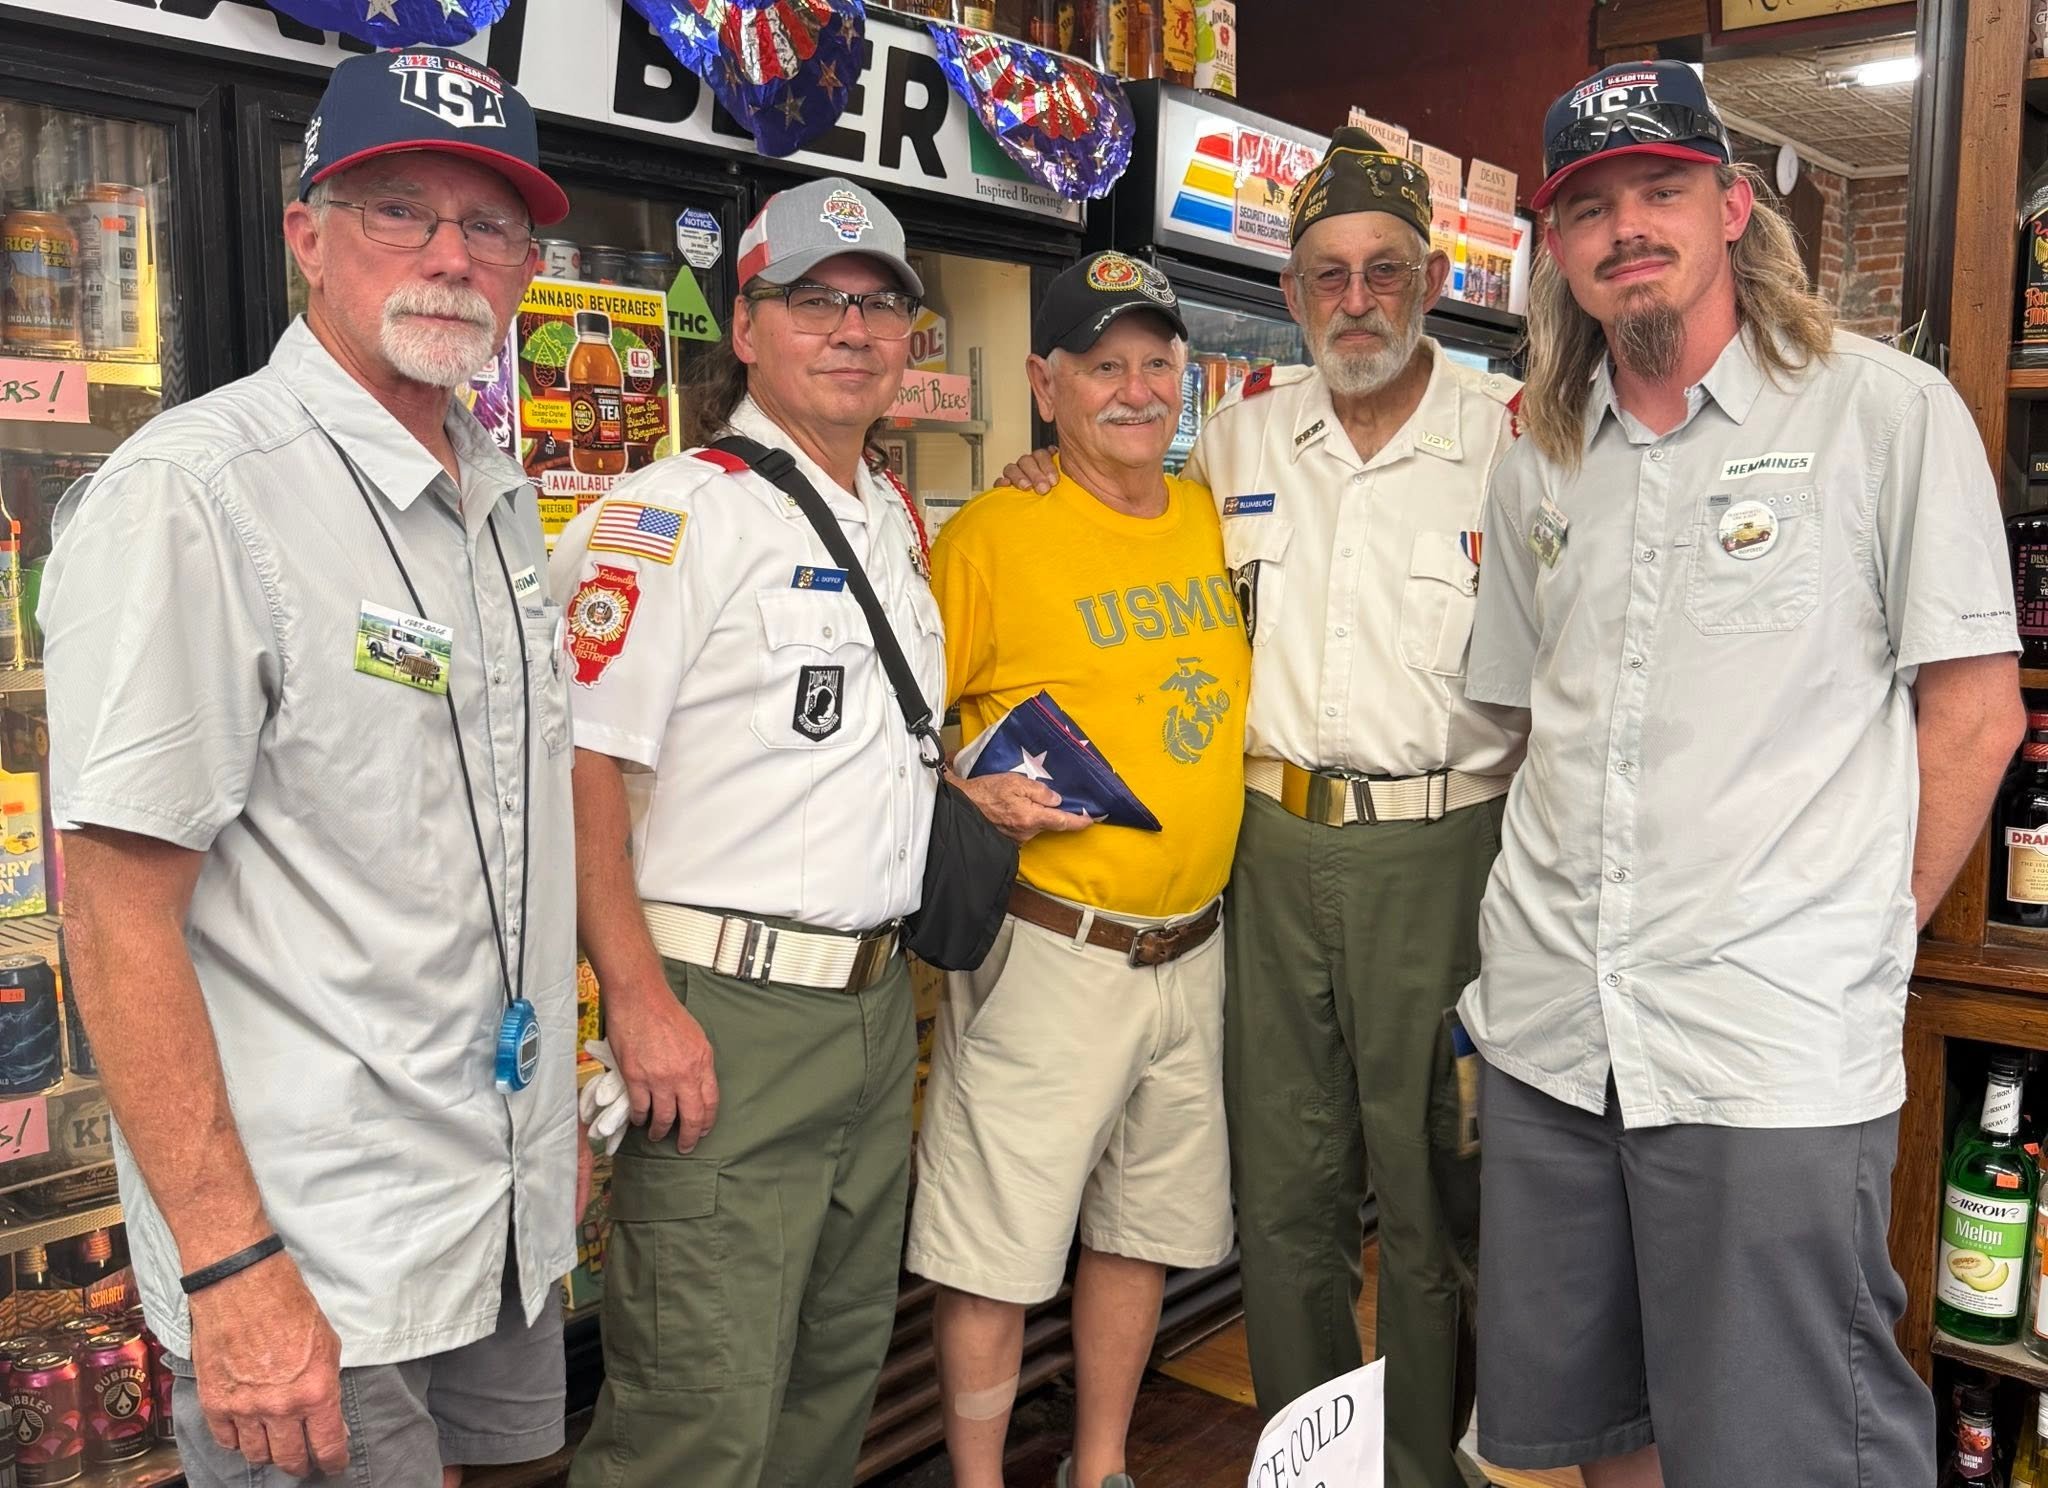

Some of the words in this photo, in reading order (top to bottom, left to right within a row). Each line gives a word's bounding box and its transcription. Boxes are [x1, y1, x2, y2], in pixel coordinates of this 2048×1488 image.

[1216, 49, 1235, 67] APPLE
[399, 70, 507, 128] USA
[1480, 167, 1507, 188] DEAN'S
[975, 178, 1018, 202] Inspired
[1021, 186, 1063, 213] Brewing
[684, 217, 713, 229] NOTICE
[1239, 205, 1267, 221] SECURITY
[1239, 220, 1257, 234] AUDIO
[524, 289, 585, 310] CANNABIS
[668, 310, 709, 335] THC
[599, 405, 621, 421] TEA
[1239, 498, 1273, 510] BLUMBURG
[599, 568, 637, 590] Friendly
[1074, 575, 1240, 648] USMC
[573, 649, 614, 665] DISTRICT
[575, 641, 599, 653] 12TH
[1950, 1195, 2020, 1218] ARROW
[1954, 1216, 2003, 1246] Melon
[94, 1367, 147, 1394] BUBBLES
[1290, 1393, 1356, 1477] COLD
